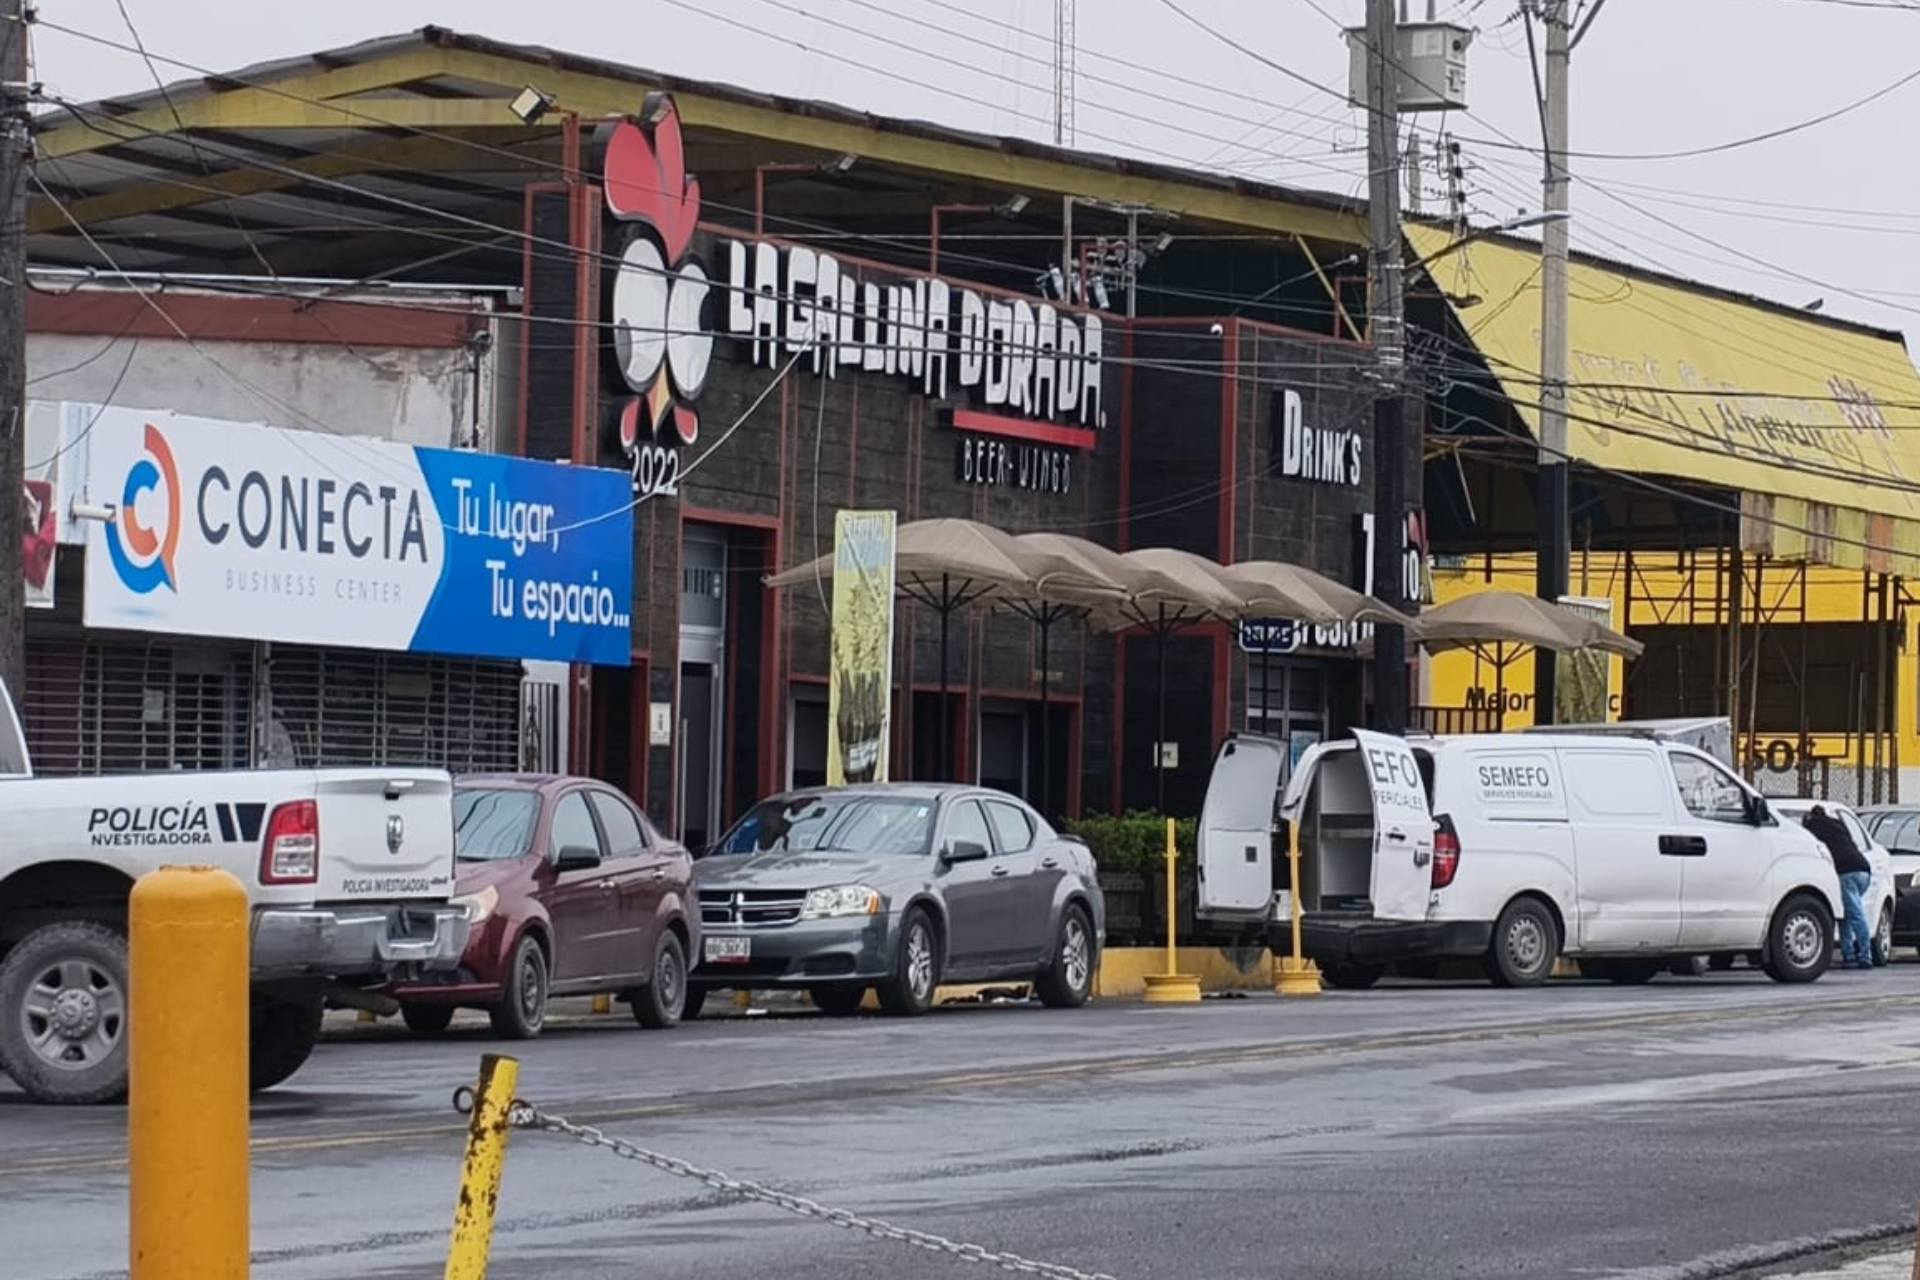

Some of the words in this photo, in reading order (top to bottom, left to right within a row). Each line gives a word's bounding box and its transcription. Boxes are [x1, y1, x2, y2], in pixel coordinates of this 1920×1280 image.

[730, 240, 777, 370] LA
[785, 246, 949, 400] GALLINA
[631, 446, 678, 496] 2022
[197, 465, 428, 563] CONECTA
[451, 477, 480, 536] Tu
[489, 482, 560, 557] lugar,
[226, 568, 317, 597] BUSINESS
[335, 578, 403, 602] CENTER
[486, 559, 515, 617] Tu
[1479, 765, 1549, 787] SEMEFO
[88, 800, 208, 822] POLICÍA
[91, 822, 212, 846] NVESTIGADORA
